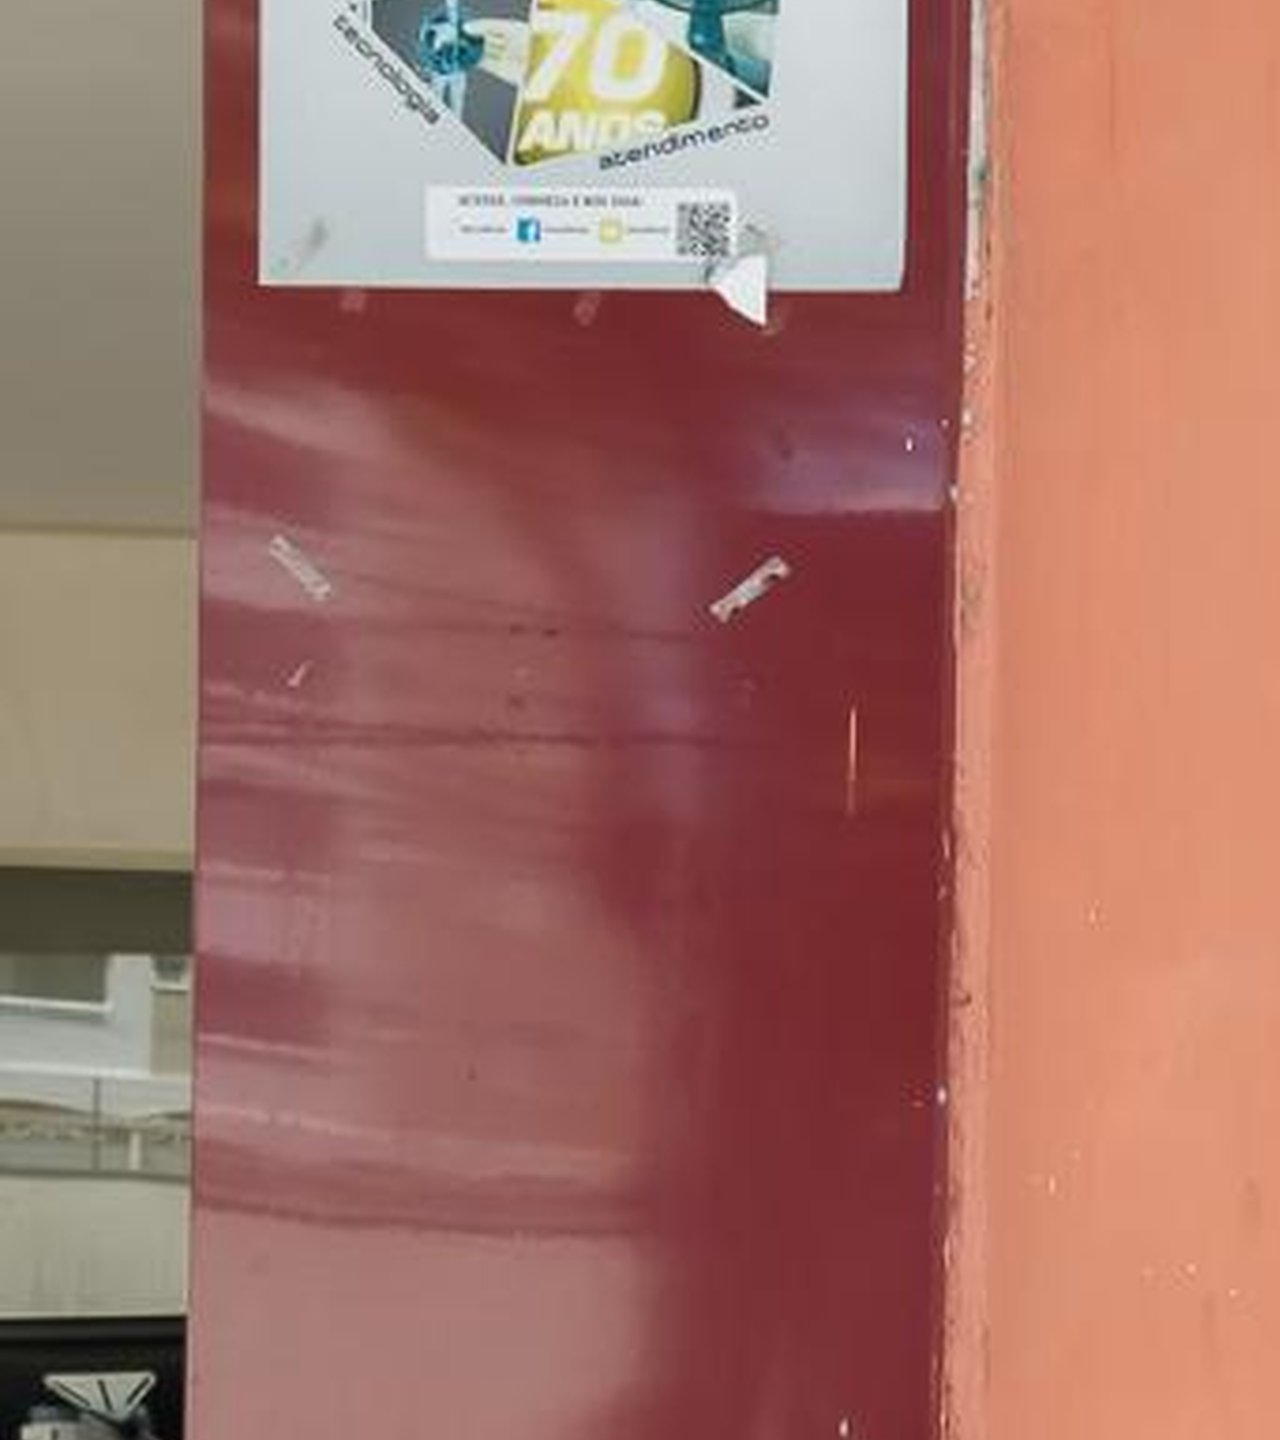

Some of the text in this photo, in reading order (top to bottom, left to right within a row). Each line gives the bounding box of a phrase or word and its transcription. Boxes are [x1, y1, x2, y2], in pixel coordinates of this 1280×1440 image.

[332, 12, 441, 126] tecnologia
[522, 11, 669, 102] 70
[517, 110, 668, 154] ANOS
[599, 112, 771, 171] atendimento
